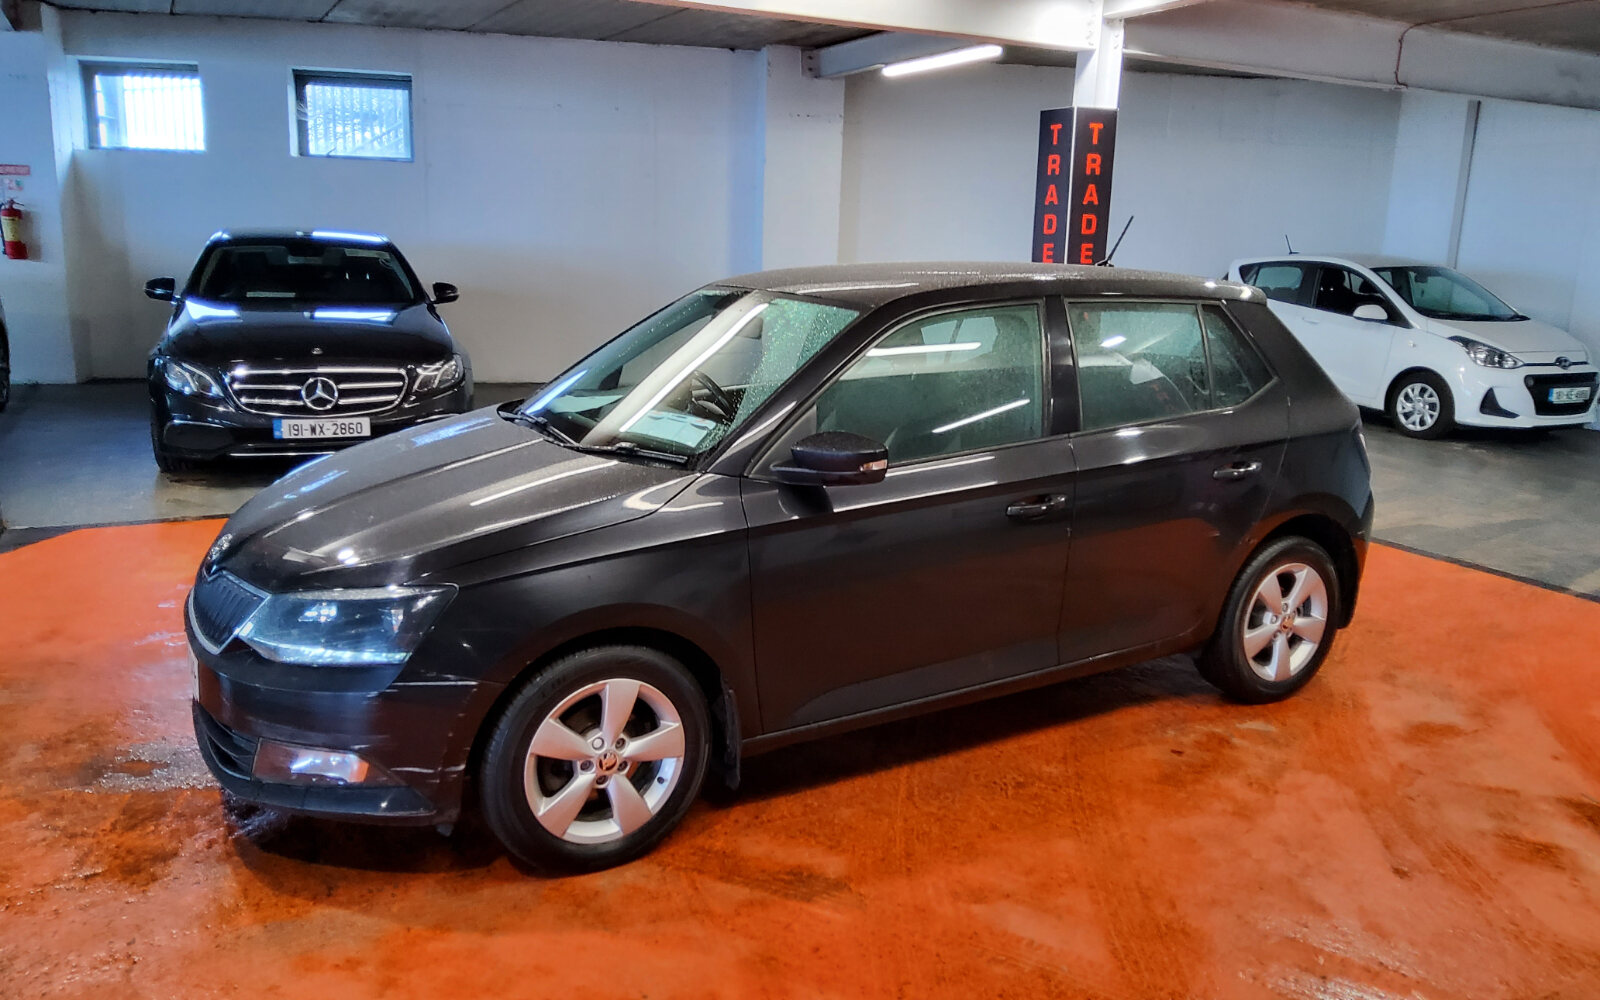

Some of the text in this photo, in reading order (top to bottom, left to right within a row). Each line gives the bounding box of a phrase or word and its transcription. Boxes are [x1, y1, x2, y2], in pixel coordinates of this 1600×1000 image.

[1042, 123, 1063, 263] TRADE
[1080, 122, 1104, 264] TRADE
[288, 422, 363, 437] 191-WX-2860
